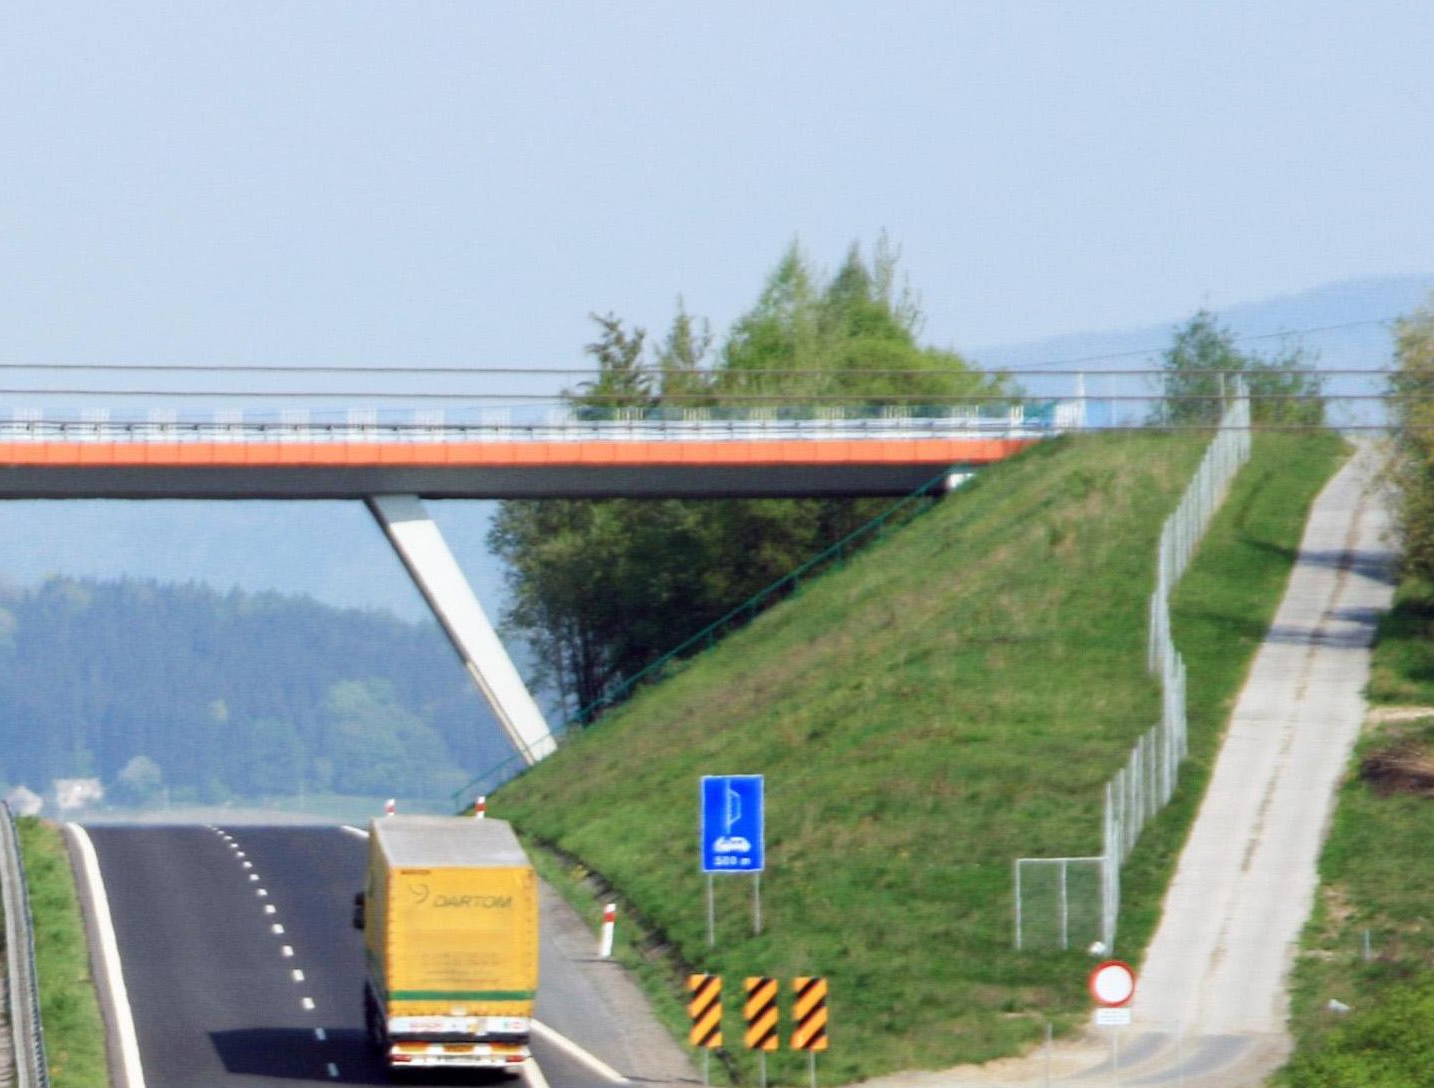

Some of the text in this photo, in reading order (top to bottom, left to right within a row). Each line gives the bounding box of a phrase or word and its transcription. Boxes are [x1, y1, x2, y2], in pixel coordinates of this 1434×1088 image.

[714, 856, 751, 865] 500 m
[433, 894, 512, 908] DARTOM
